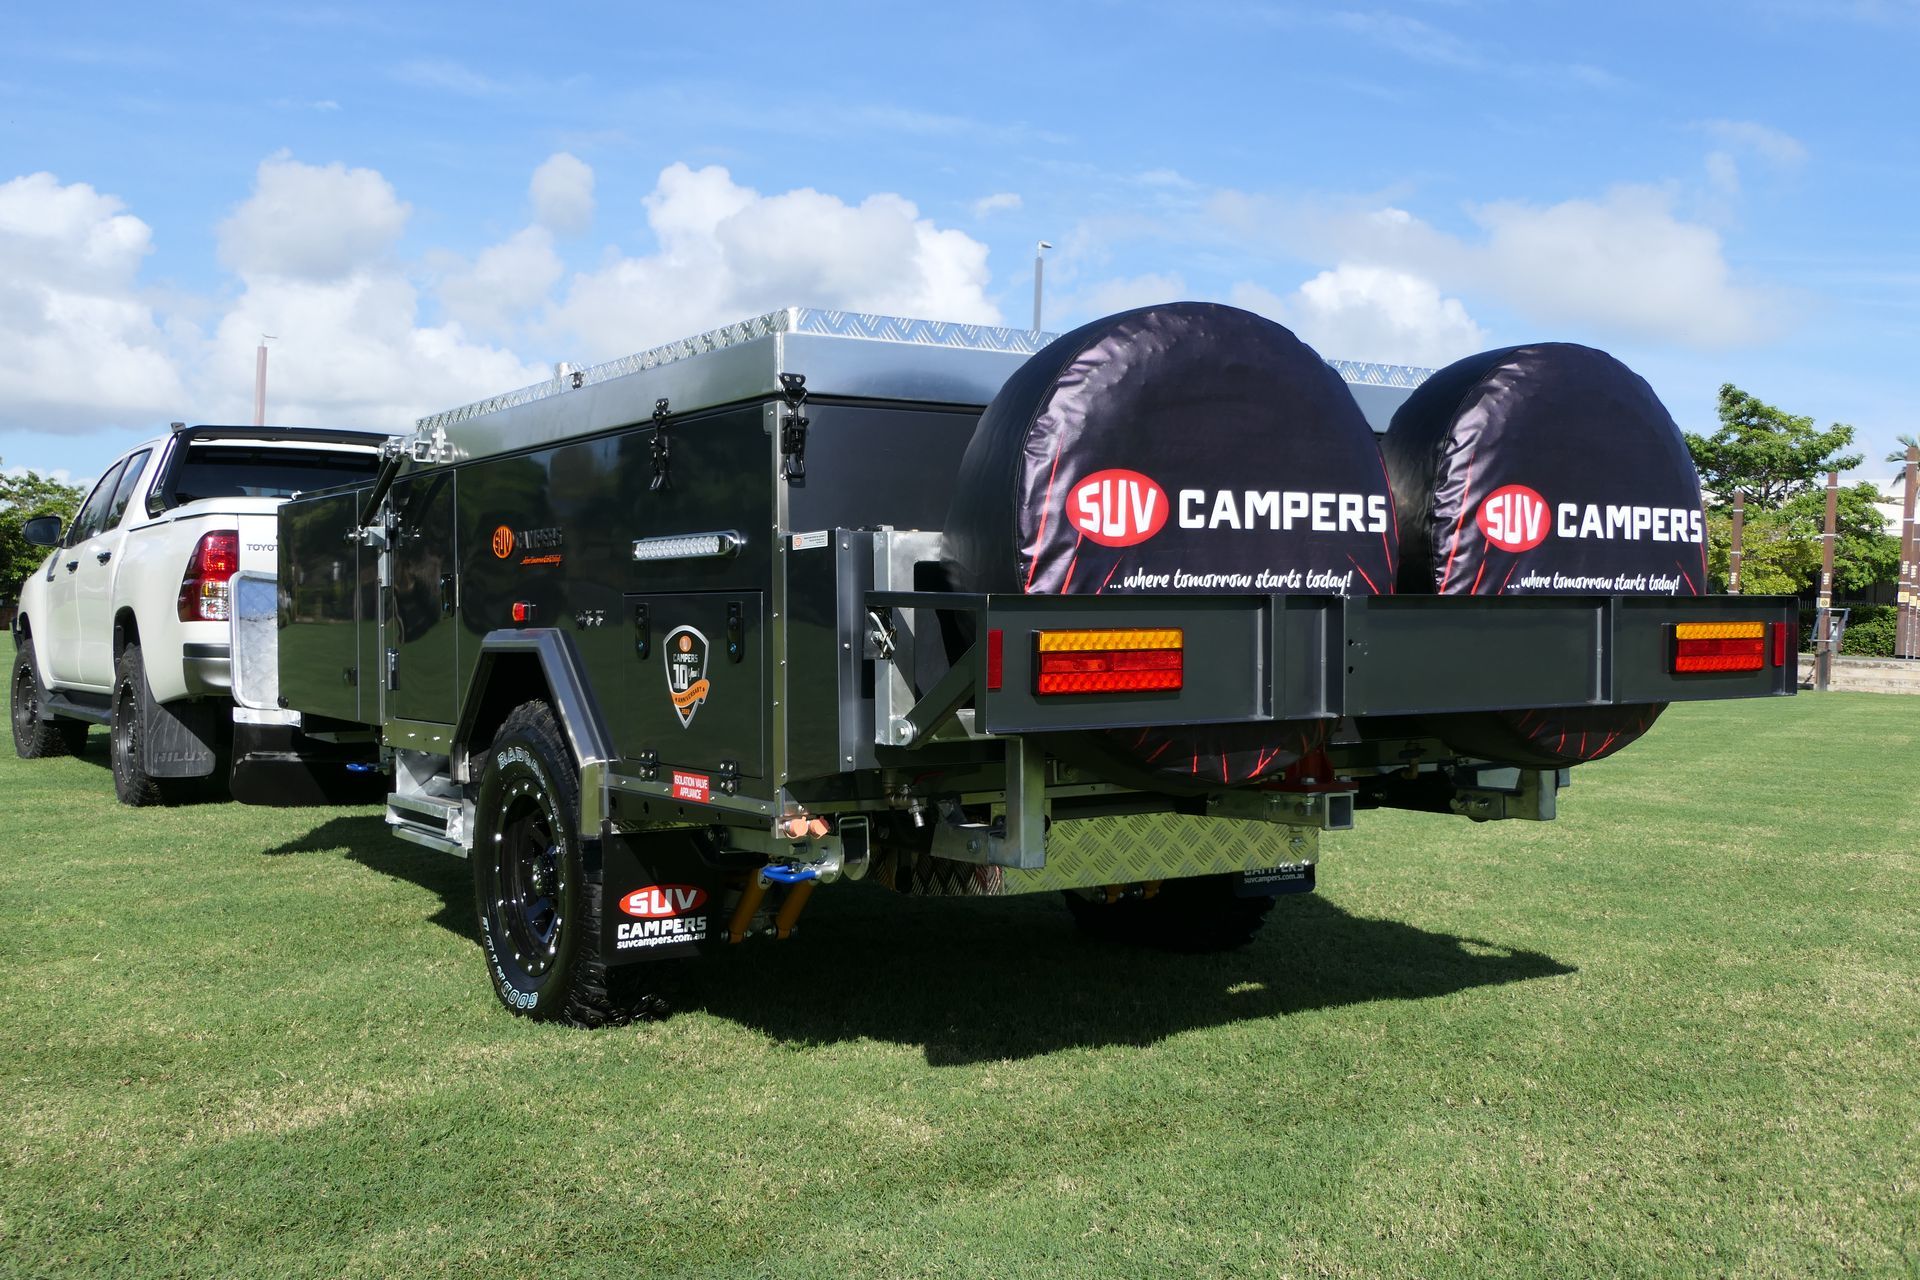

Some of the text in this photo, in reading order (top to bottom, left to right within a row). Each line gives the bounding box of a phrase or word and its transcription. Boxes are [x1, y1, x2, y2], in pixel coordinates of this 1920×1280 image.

[1077, 479, 1388, 537] SUV CAMPERS
[1485, 493, 1703, 544] SUV CAMPERS
[1173, 568, 1252, 589] tomorrow
[1255, 568, 1301, 589] starts
[1305, 569, 1353, 595] today!
[1553, 571, 1613, 590] tomorrow
[1614, 573, 1645, 590] starts
[1648, 574, 1681, 595] today!
[673, 654, 698, 662] CAMPERS
[673, 664, 688, 689] 10
[680, 787, 701, 799] APPLIANCE
[1244, 873, 1305, 884] suvcampers.com.au
[629, 888, 697, 915] SUV
[617, 916, 707, 940] CAMPERS
[616, 932, 706, 949] suvcampers.com.au
